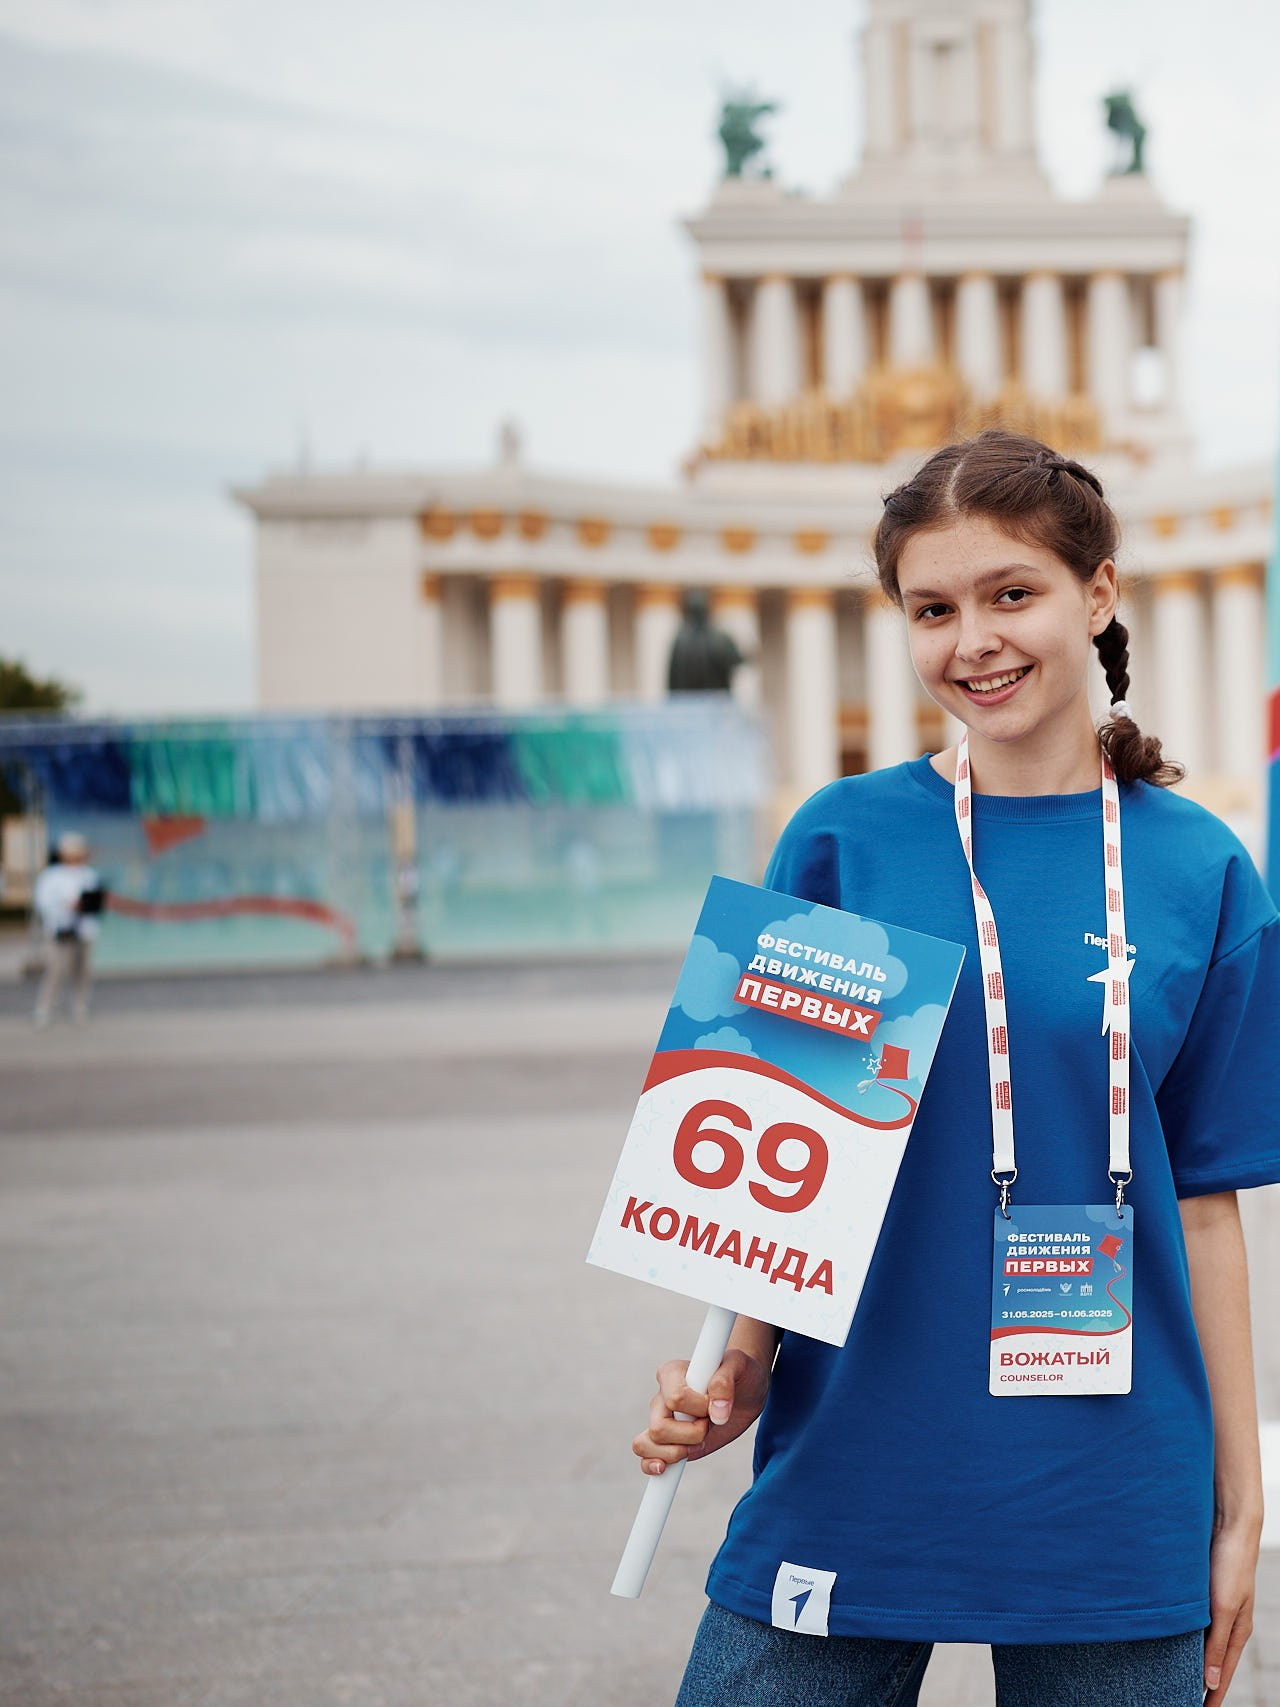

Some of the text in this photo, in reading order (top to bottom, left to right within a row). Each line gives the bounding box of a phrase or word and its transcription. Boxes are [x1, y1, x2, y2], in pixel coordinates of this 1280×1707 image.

[1084, 932, 1137, 954] Пере
[757, 933, 887, 982] ФЕСТИВАЛЬ
[748, 954, 882, 1005] ДВИЖЕНИЯ
[739, 979, 873, 1035] ПЕРВЫХ
[673, 1099, 829, 1214] 69
[620, 1196, 834, 1296] КОМАНДА
[1007, 1233, 1091, 1243] ФЕСТИВАЛЬ
[1007, 1246, 1091, 1256] ДВИЖЕНИЯ
[1005, 1261, 1090, 1273] ПЕРВЫХ
[1000, 1348, 1110, 1366] ВОЖАТЫЙ
[1000, 1374, 1064, 1382] COUNSELOR
